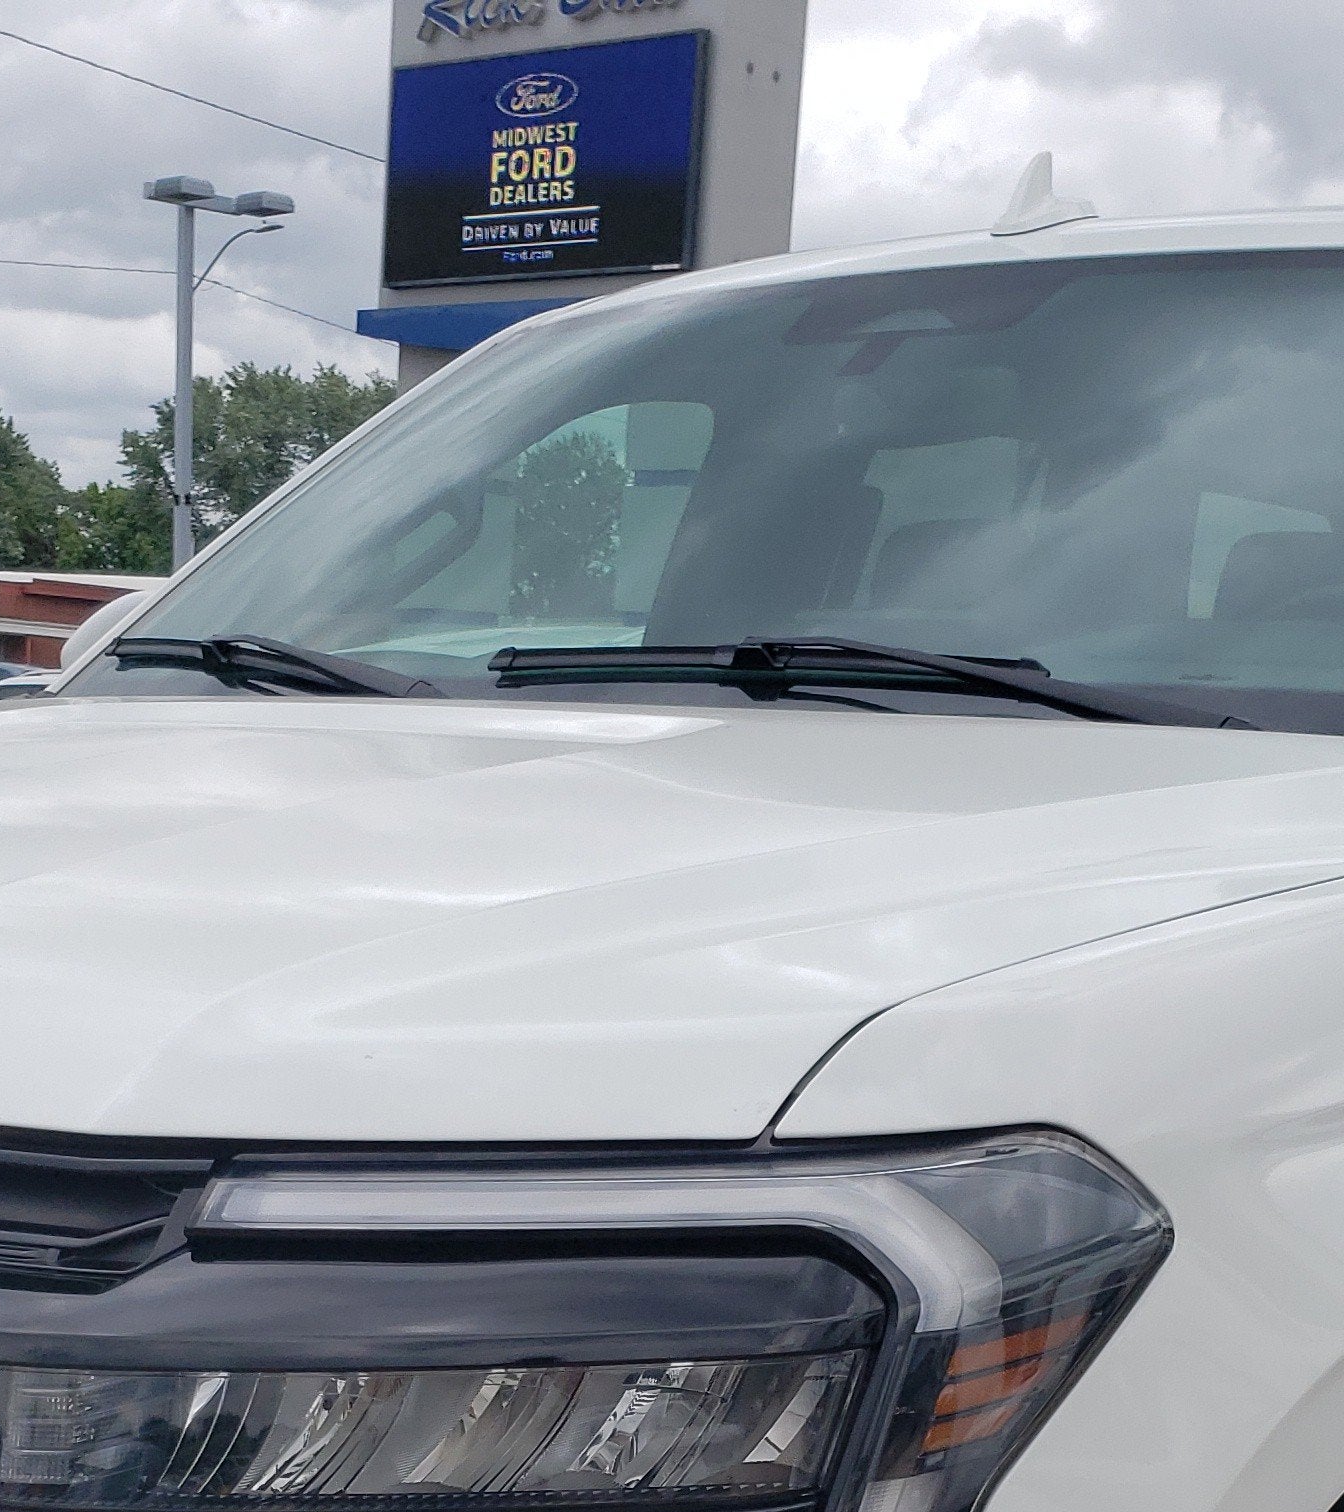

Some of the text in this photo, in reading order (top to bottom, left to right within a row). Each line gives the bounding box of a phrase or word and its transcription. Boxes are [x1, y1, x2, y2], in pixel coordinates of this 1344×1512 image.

[511, 81, 563, 111] Ford
[492, 122, 578, 148] MIDWEST
[491, 145, 577, 183] FORD
[490, 179, 574, 206] DEALERS
[462, 218, 599, 242] DRIVEN BY VALUE
